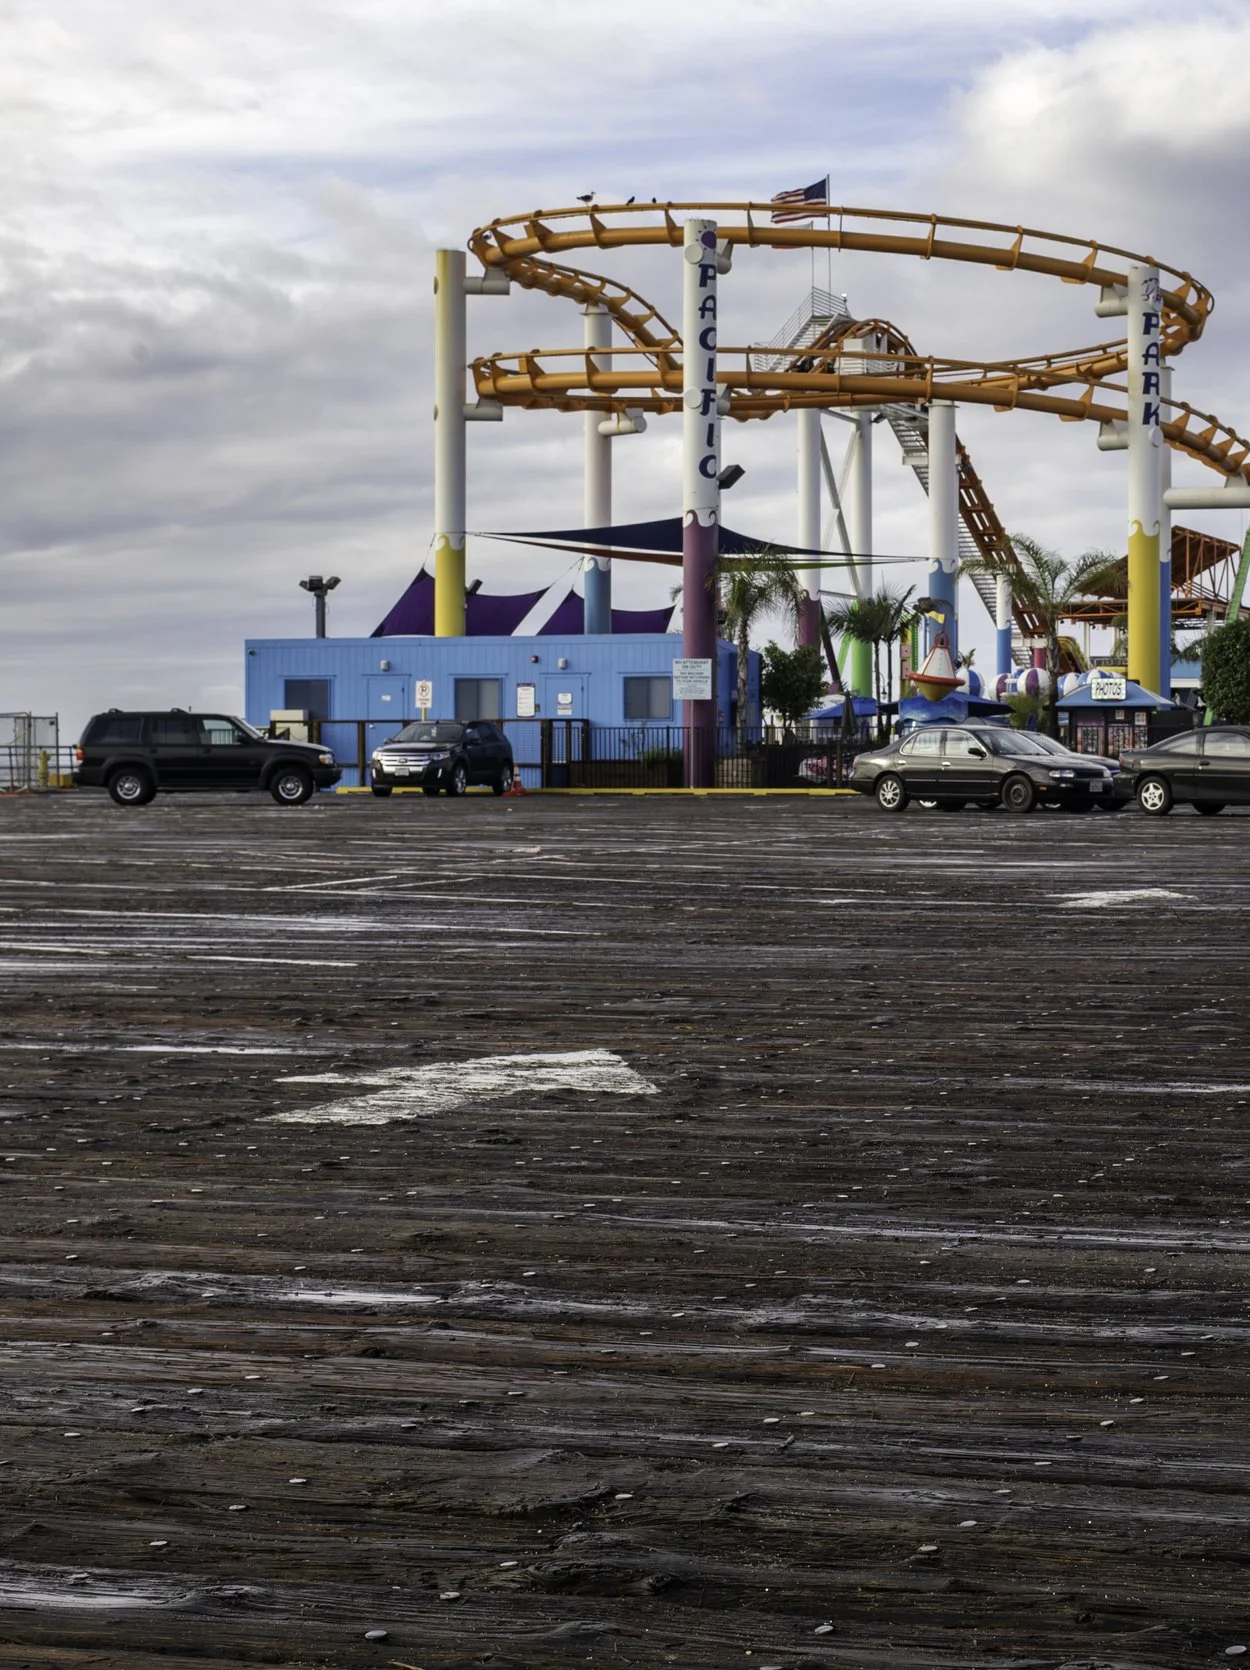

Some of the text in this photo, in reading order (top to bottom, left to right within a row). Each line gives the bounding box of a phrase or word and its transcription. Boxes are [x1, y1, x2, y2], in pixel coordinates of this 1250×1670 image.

[699, 264, 717, 478] PACIFIC
[1142, 312, 1160, 426] PARK
[1095, 682, 1123, 696] PHOTOS
